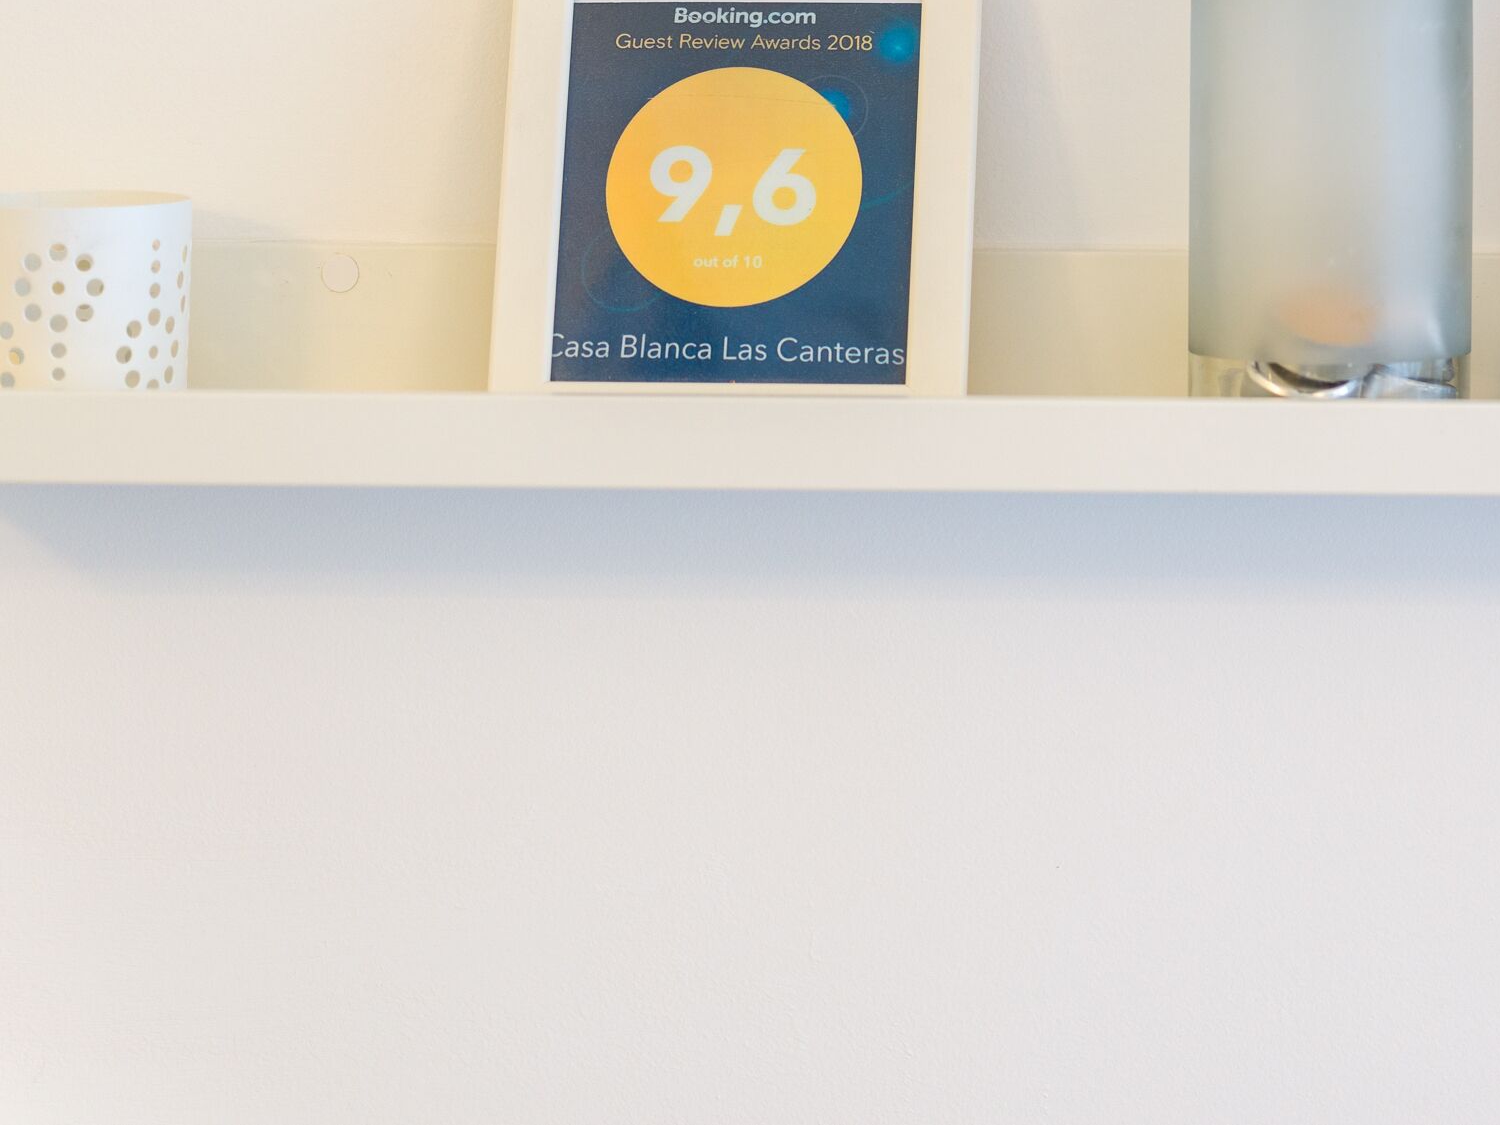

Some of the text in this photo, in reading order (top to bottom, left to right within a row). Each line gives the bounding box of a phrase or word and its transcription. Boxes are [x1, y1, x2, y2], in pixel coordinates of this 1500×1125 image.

[673, 6, 818, 28] Booking.com
[615, 33, 873, 51] Guest Review Awards 2018
[649, 145, 817, 237] 9,6
[693, 254, 763, 269] out of 10
[552, 333, 905, 366] Casa Blanca Las Canteras
